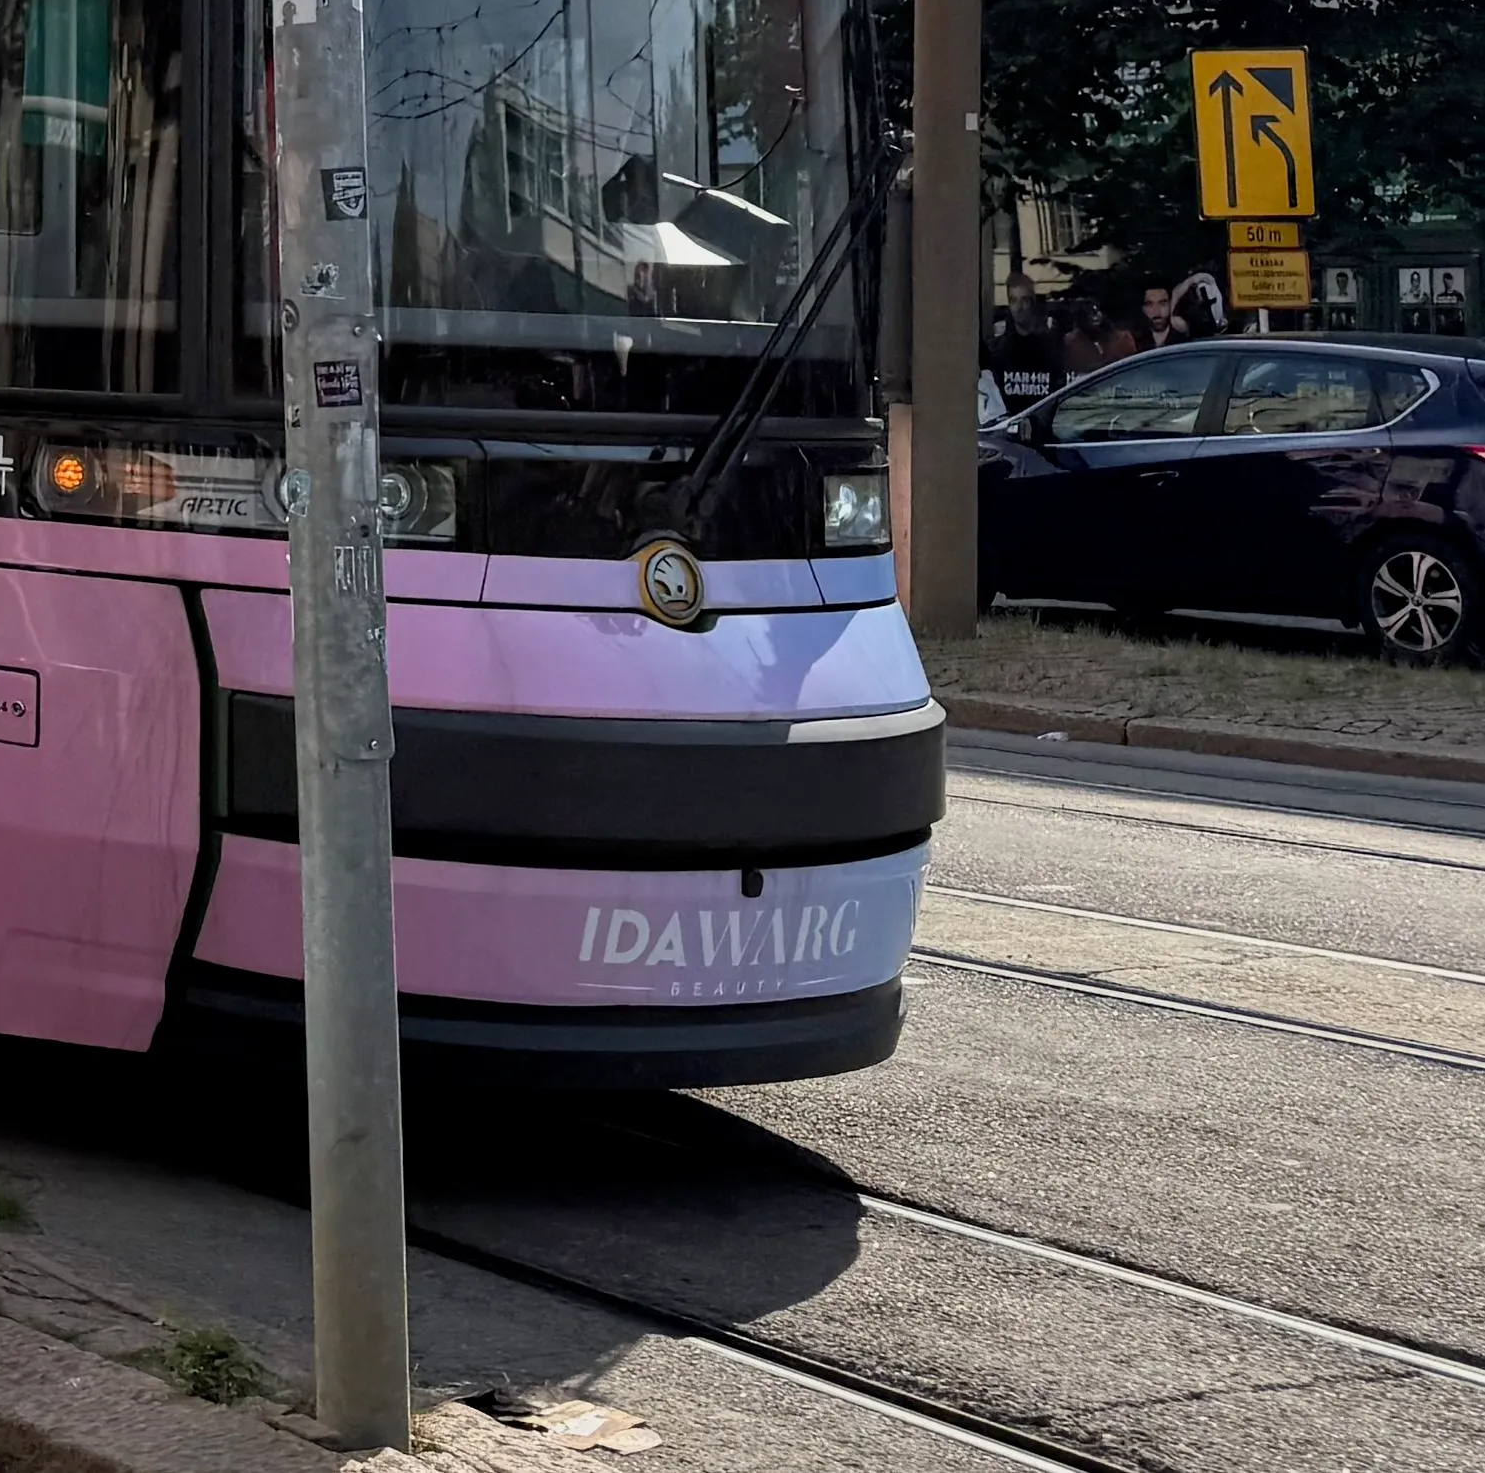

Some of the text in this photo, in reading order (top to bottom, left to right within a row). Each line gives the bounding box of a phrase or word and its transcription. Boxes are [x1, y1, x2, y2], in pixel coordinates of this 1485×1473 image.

[1269, 229, 1282, 243] m
[180, 496, 248, 517] ARTIC
[669, 977, 786, 997] BEAUTY
